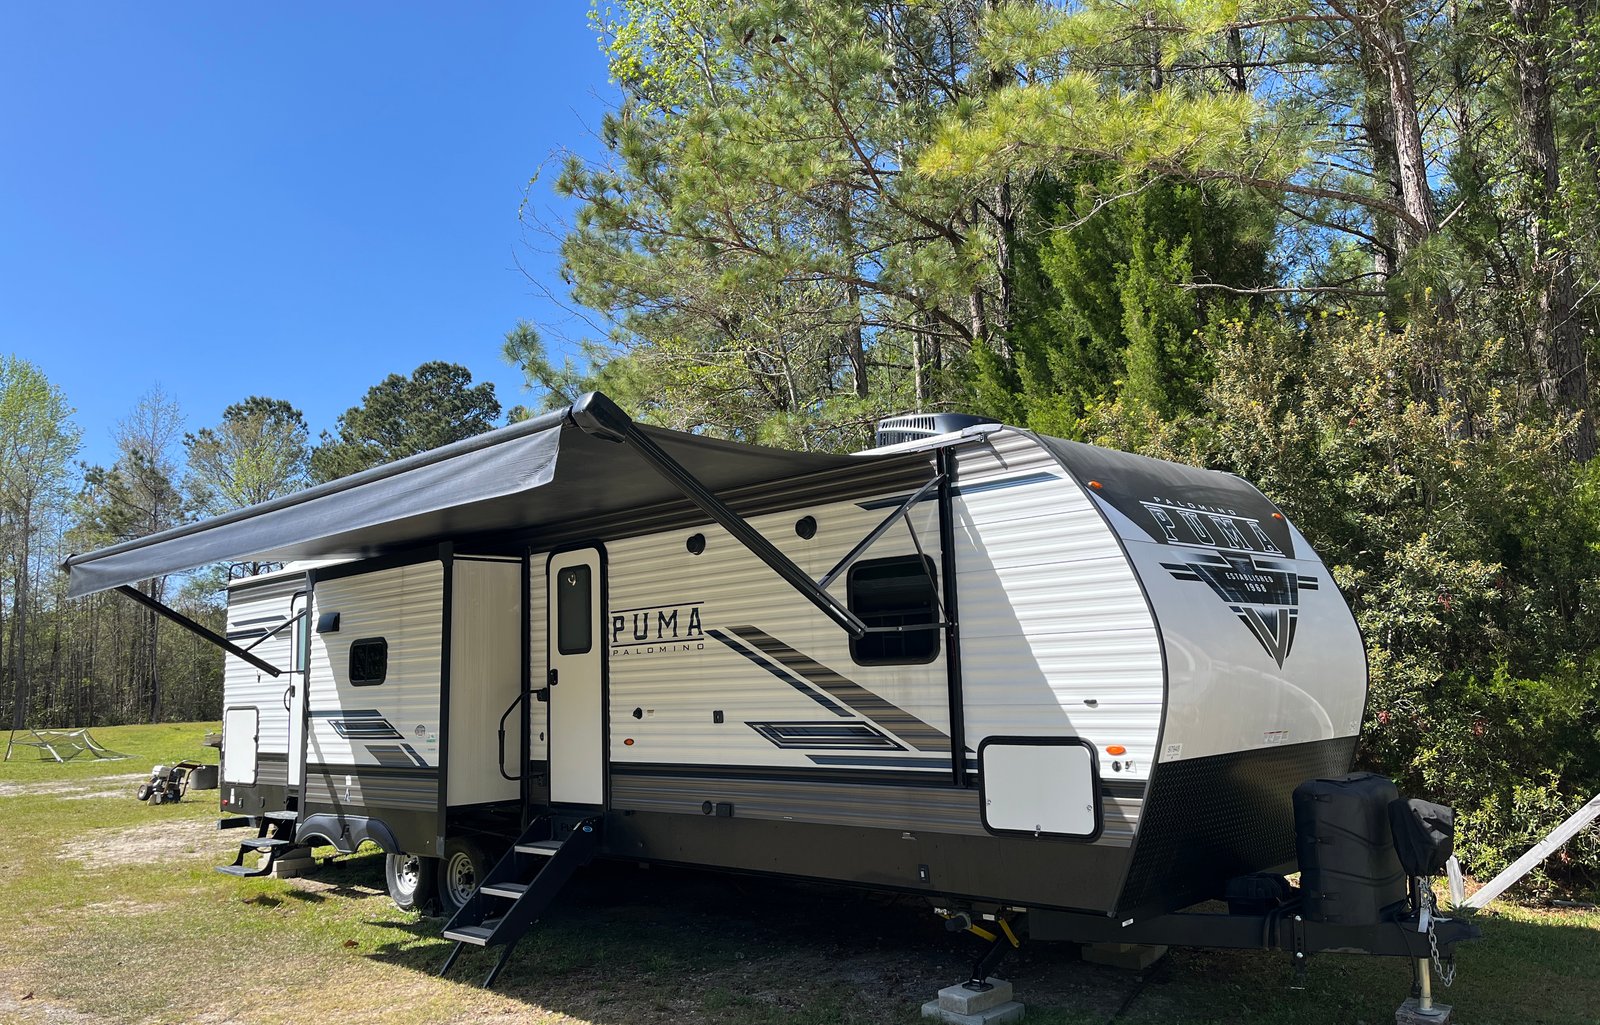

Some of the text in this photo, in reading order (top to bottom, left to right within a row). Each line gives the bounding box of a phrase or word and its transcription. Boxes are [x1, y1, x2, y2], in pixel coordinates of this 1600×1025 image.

[1153, 496, 1236, 515] PALOMINO
[1144, 505, 1282, 553] PUMA
[1225, 572, 1274, 583] ESTABLISHED
[612, 607, 704, 643] PUMA
[613, 643, 704, 656] PALOMINO
